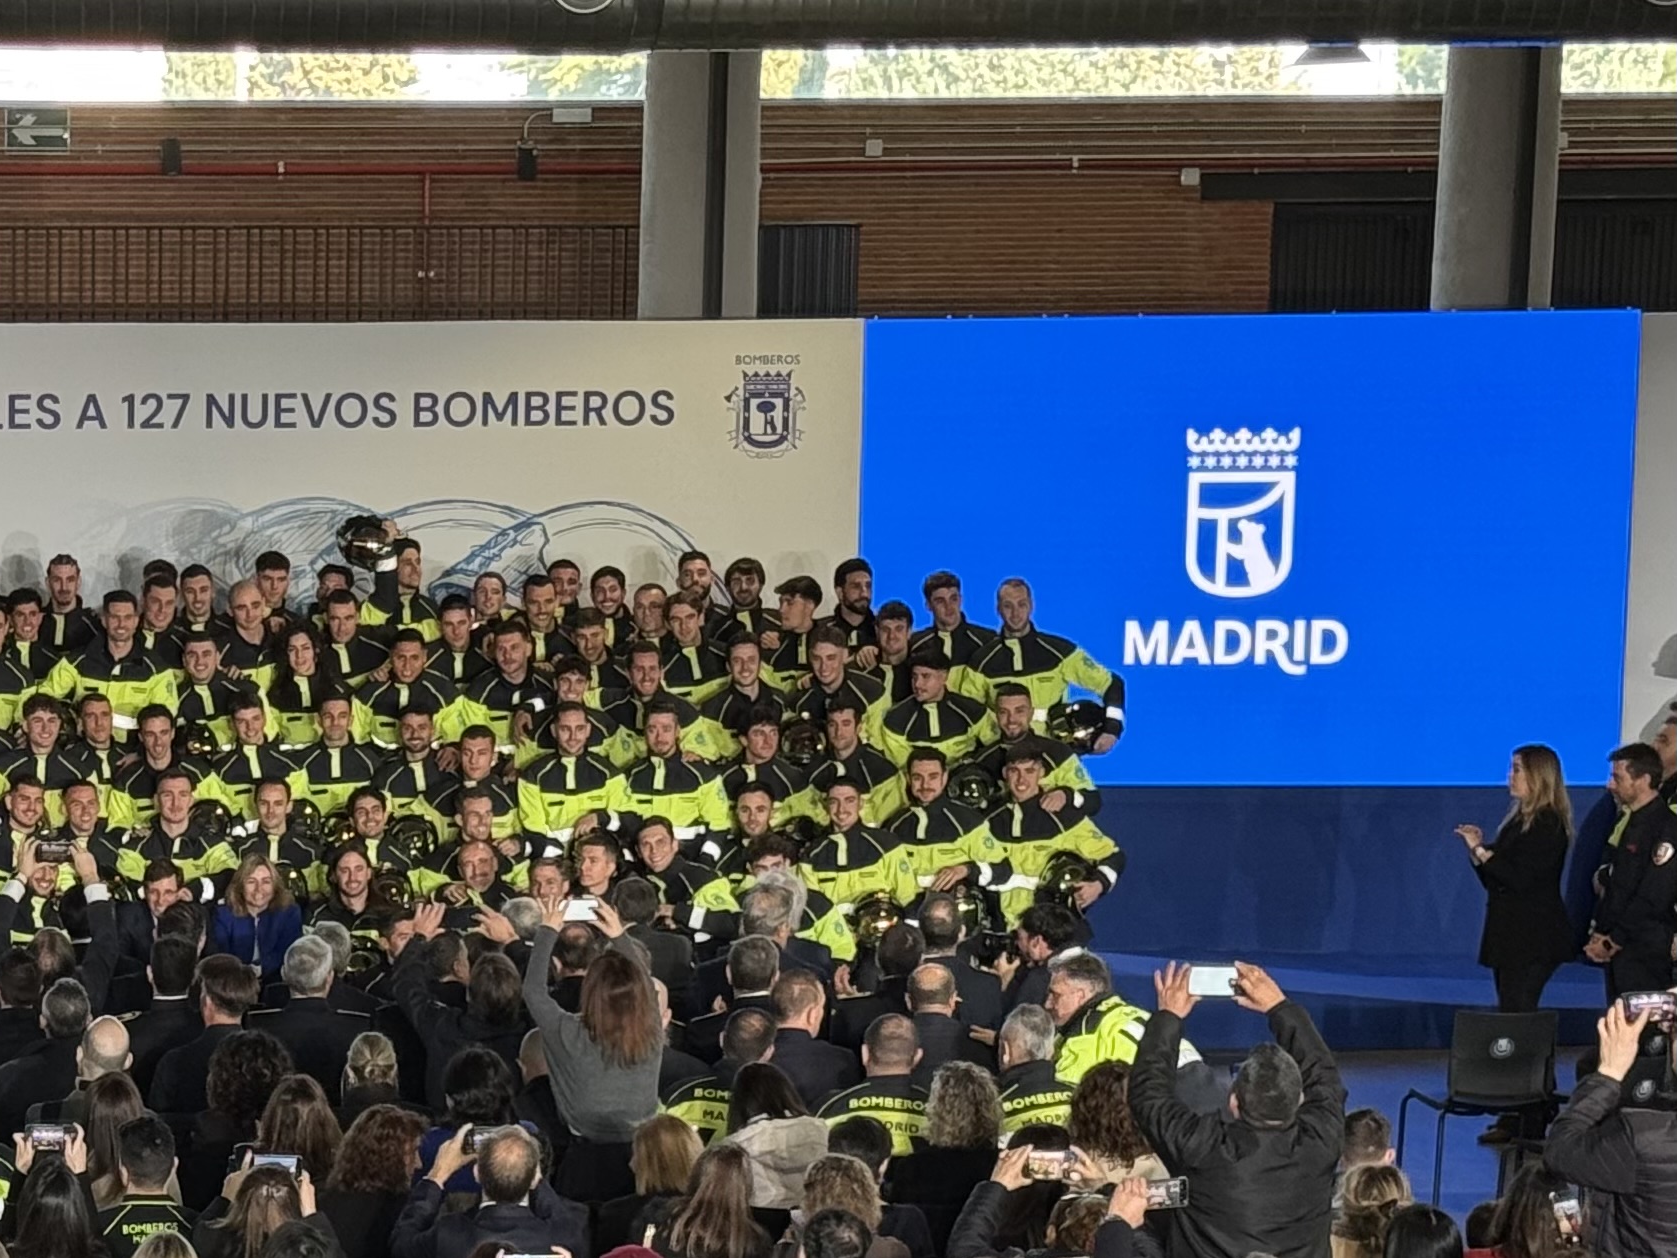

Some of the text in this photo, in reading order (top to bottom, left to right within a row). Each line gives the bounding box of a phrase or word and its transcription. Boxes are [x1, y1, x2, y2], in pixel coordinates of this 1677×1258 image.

[735, 354, 801, 365] BOMBEROS
[75, 393, 108, 430] A
[121, 392, 191, 430] 127
[205, 391, 397, 430] NUEVOS
[413, 389, 675, 428] BOMBEROS
[1124, 619, 1349, 676] MADRID
[848, 1096, 926, 1111] BOMBERO
[1003, 1091, 1073, 1112] BOMBERO
[883, 1120, 919, 1134] DRID
[122, 1222, 179, 1235] BOMBEROS
